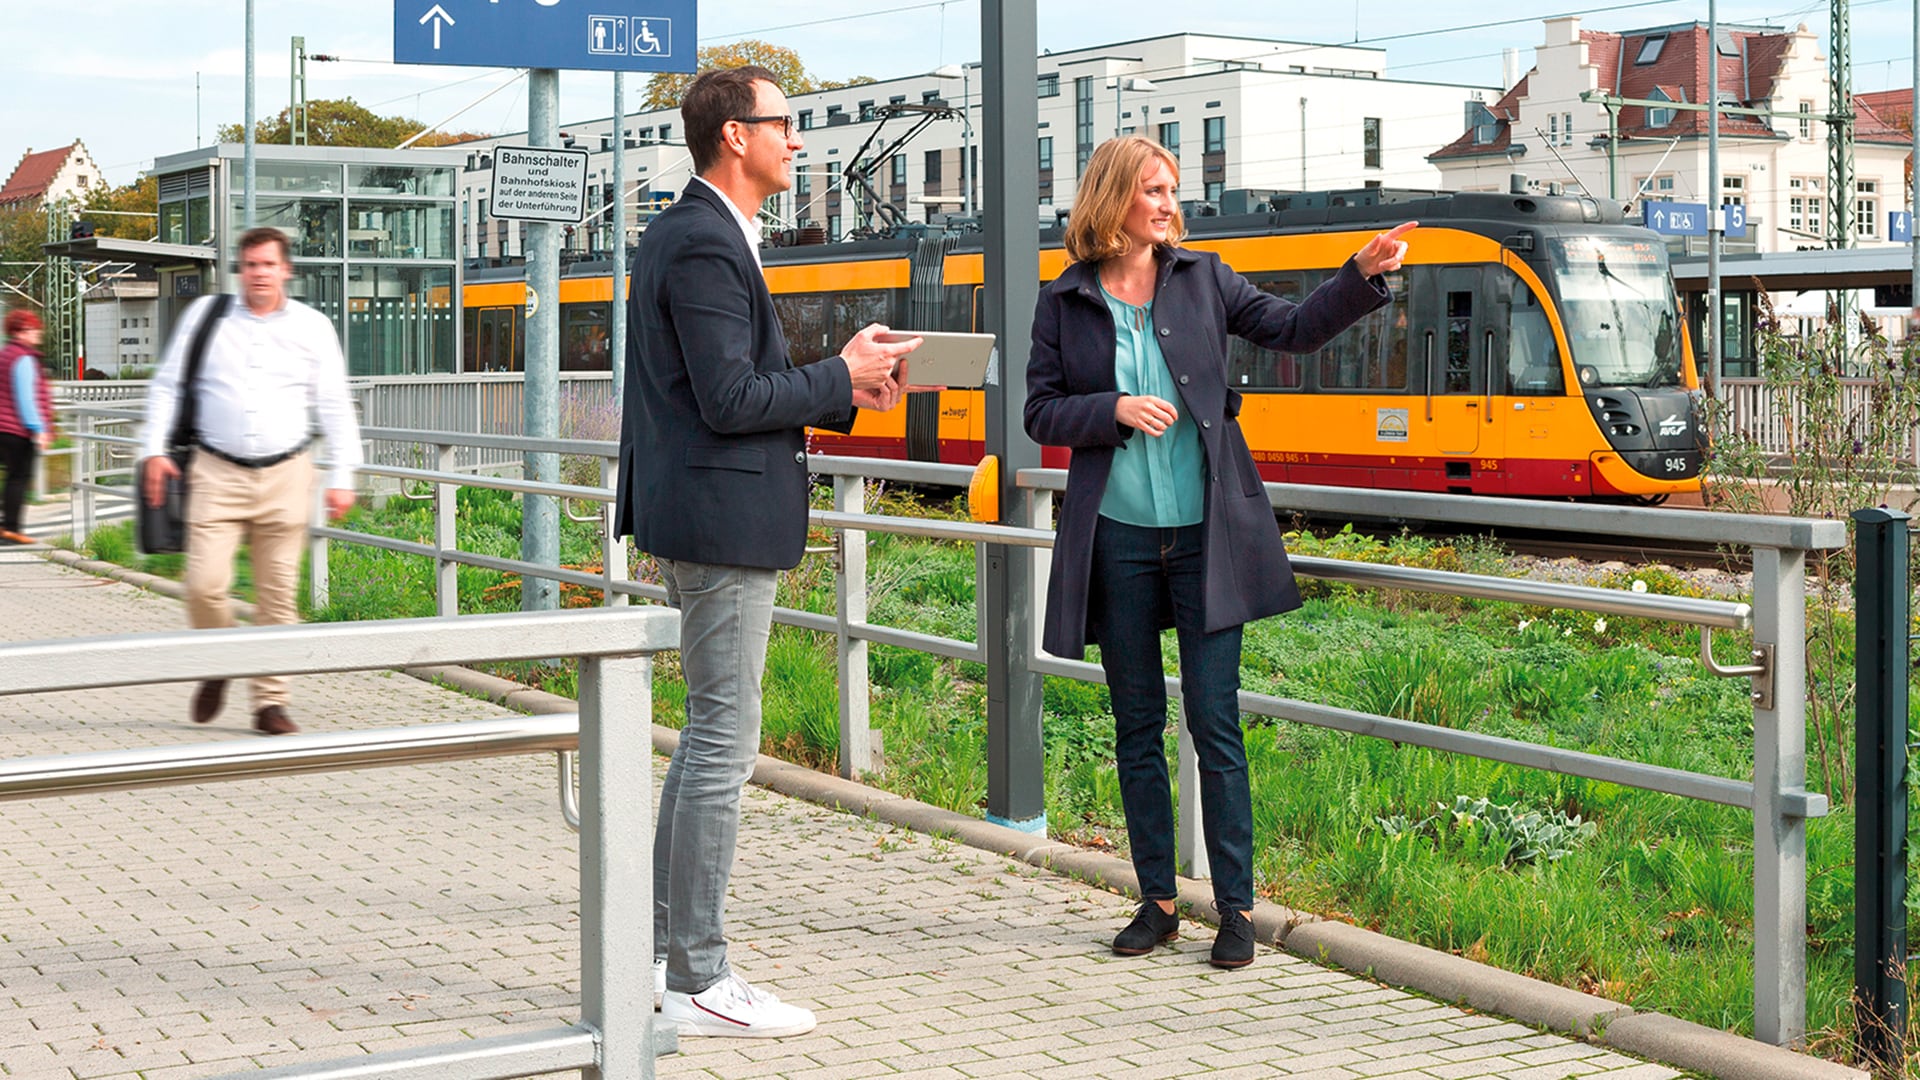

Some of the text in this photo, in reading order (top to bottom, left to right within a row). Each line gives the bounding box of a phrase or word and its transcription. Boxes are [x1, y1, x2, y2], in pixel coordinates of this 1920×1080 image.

[502, 152, 579, 168] Bahnschalter
[528, 168, 549, 176] und
[500, 176, 577, 189] Bahnhofskiosk
[499, 188, 578, 201] auf der anderen Seite
[498, 200, 577, 214] der Unterführung
[1732, 206, 1743, 228] 5
[1895, 213, 1906, 233] 4
[1480, 459, 1498, 470] 945
[1665, 458, 1686, 471] 945
